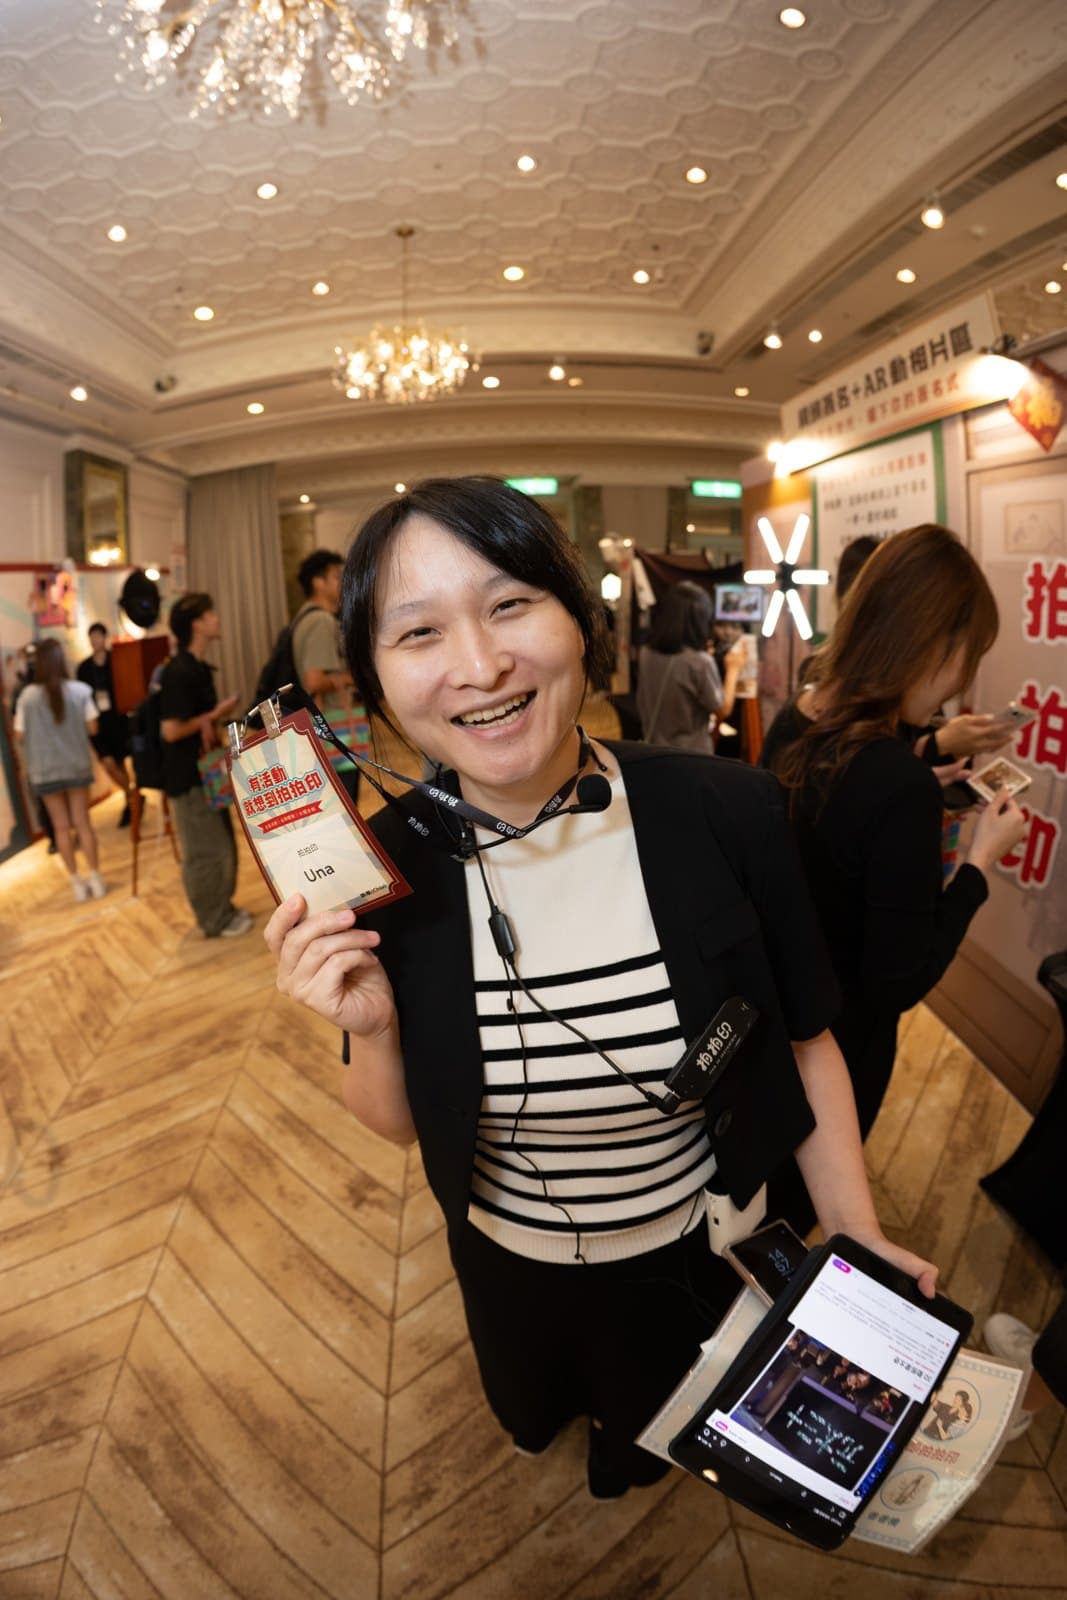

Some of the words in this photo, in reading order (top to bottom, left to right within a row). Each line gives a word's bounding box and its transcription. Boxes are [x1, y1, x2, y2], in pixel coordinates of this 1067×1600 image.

[243, 771, 324, 817] 就想到拍拍印
[248, 766, 288, 793] 有活動
[304, 864, 335, 882] Una
[696, 1021, 733, 1072] 拍拍印
